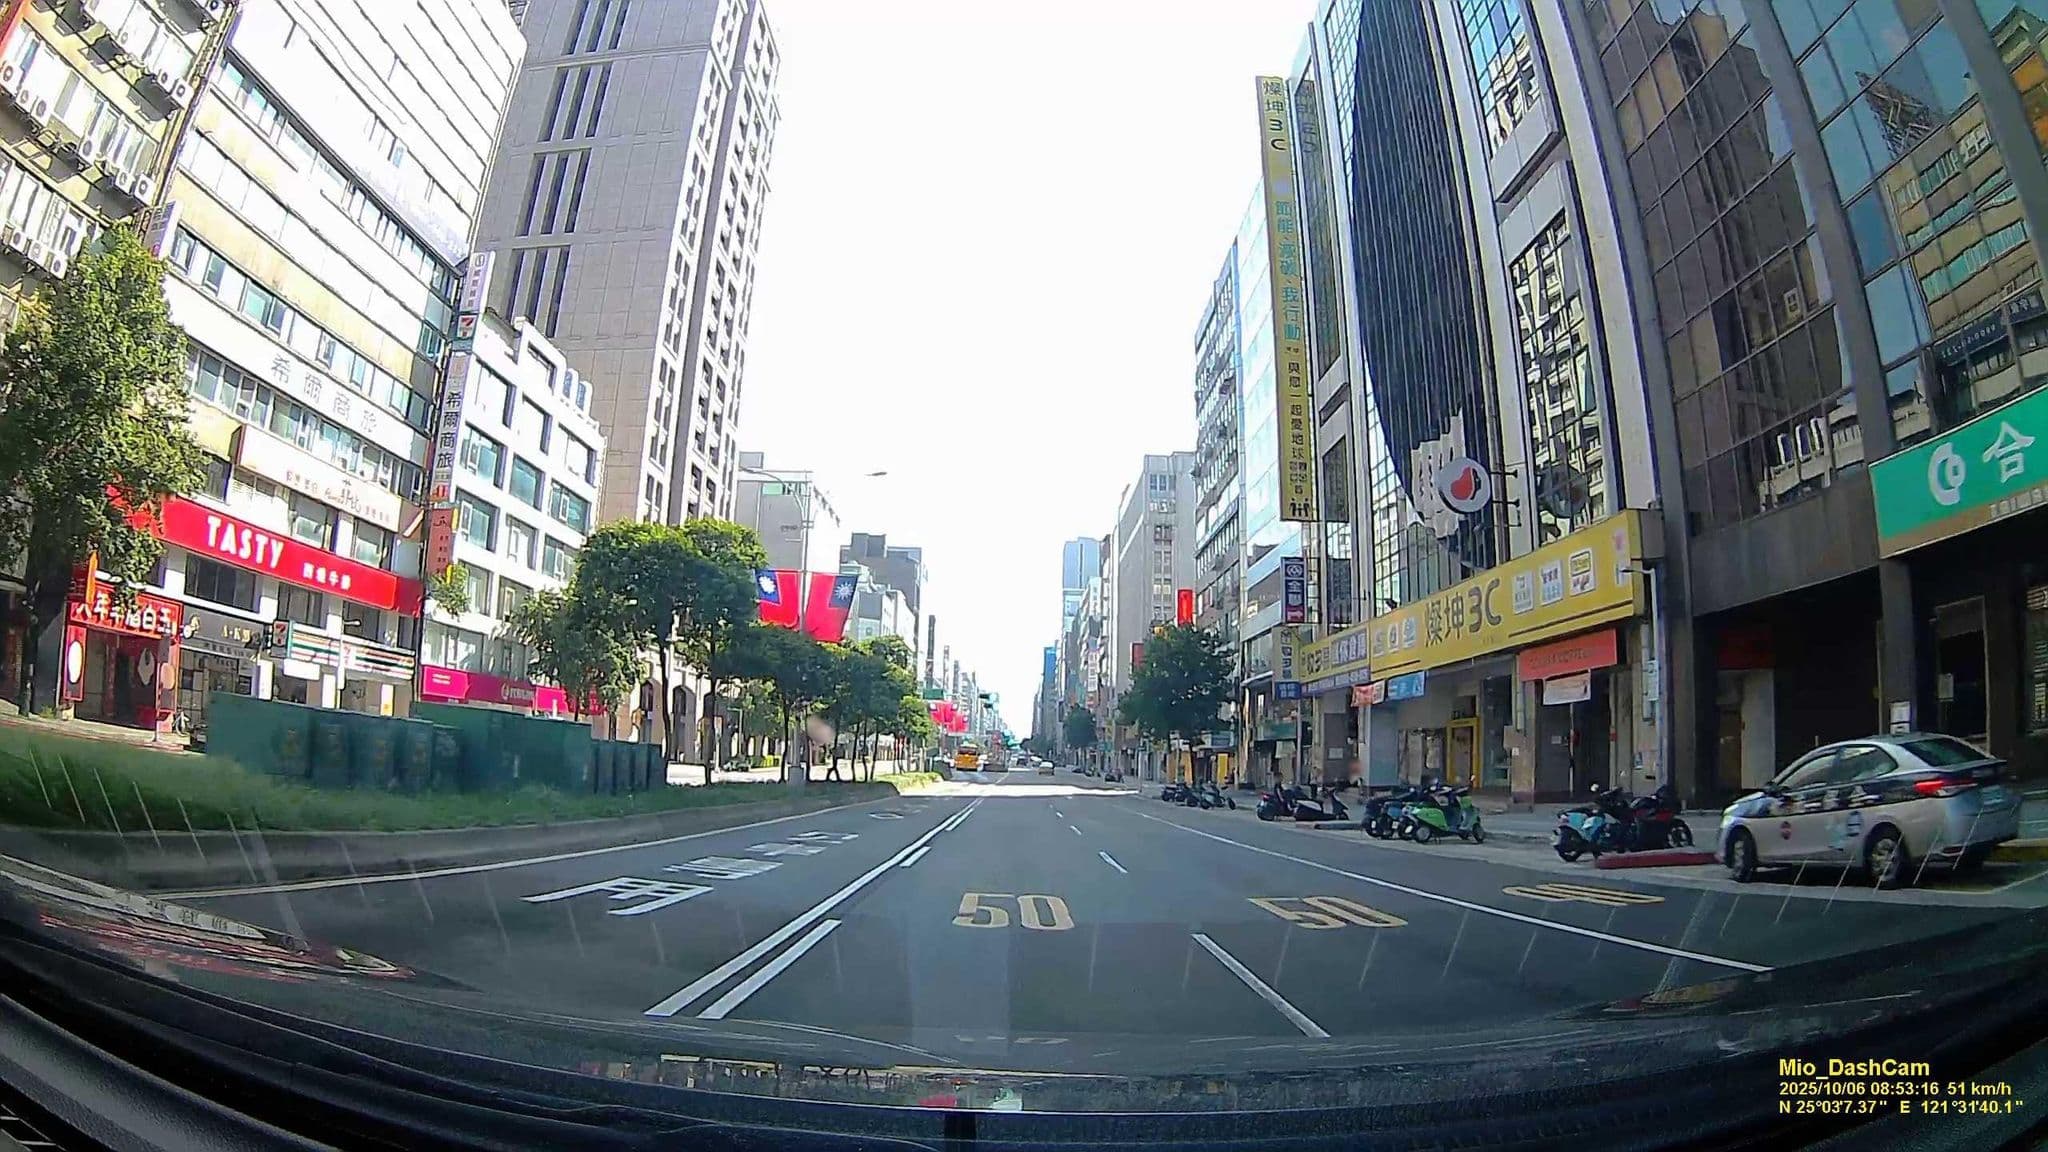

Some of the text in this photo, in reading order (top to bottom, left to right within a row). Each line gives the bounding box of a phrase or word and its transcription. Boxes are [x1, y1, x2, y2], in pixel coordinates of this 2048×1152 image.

[1262, 81, 1287, 151] 燦坤3C
[436, 391, 462, 470] 希爾商旅
[1982, 421, 2036, 483] 合
[207, 515, 284, 569] TASTY
[1424, 578, 1502, 648] 燦坤3C
[952, 892, 1074, 931] 50
[1248, 895, 1408, 930] 50
